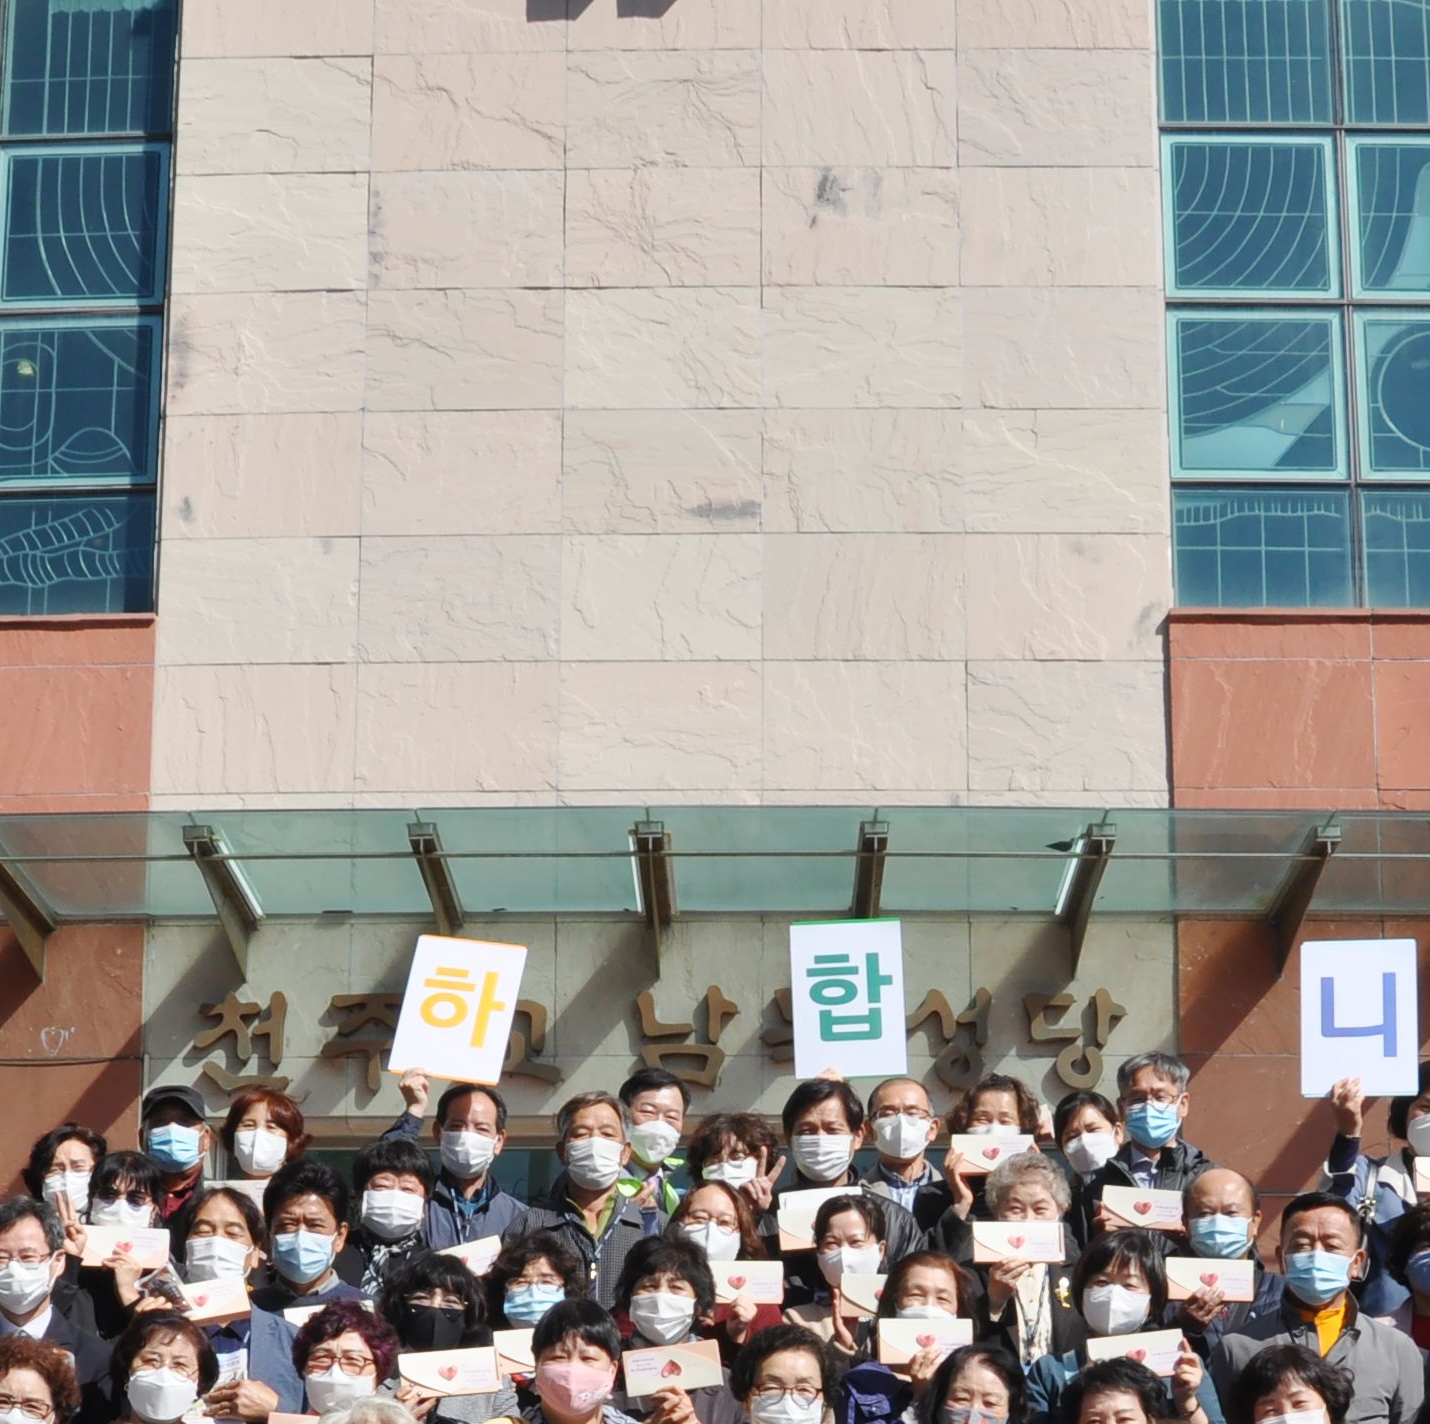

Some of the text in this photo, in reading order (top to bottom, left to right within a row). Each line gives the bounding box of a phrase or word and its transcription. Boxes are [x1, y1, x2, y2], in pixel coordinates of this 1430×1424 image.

[420, 966, 506, 1049] 하
[806, 953, 893, 1042] 합
[1321, 972, 1397, 1057] 니
